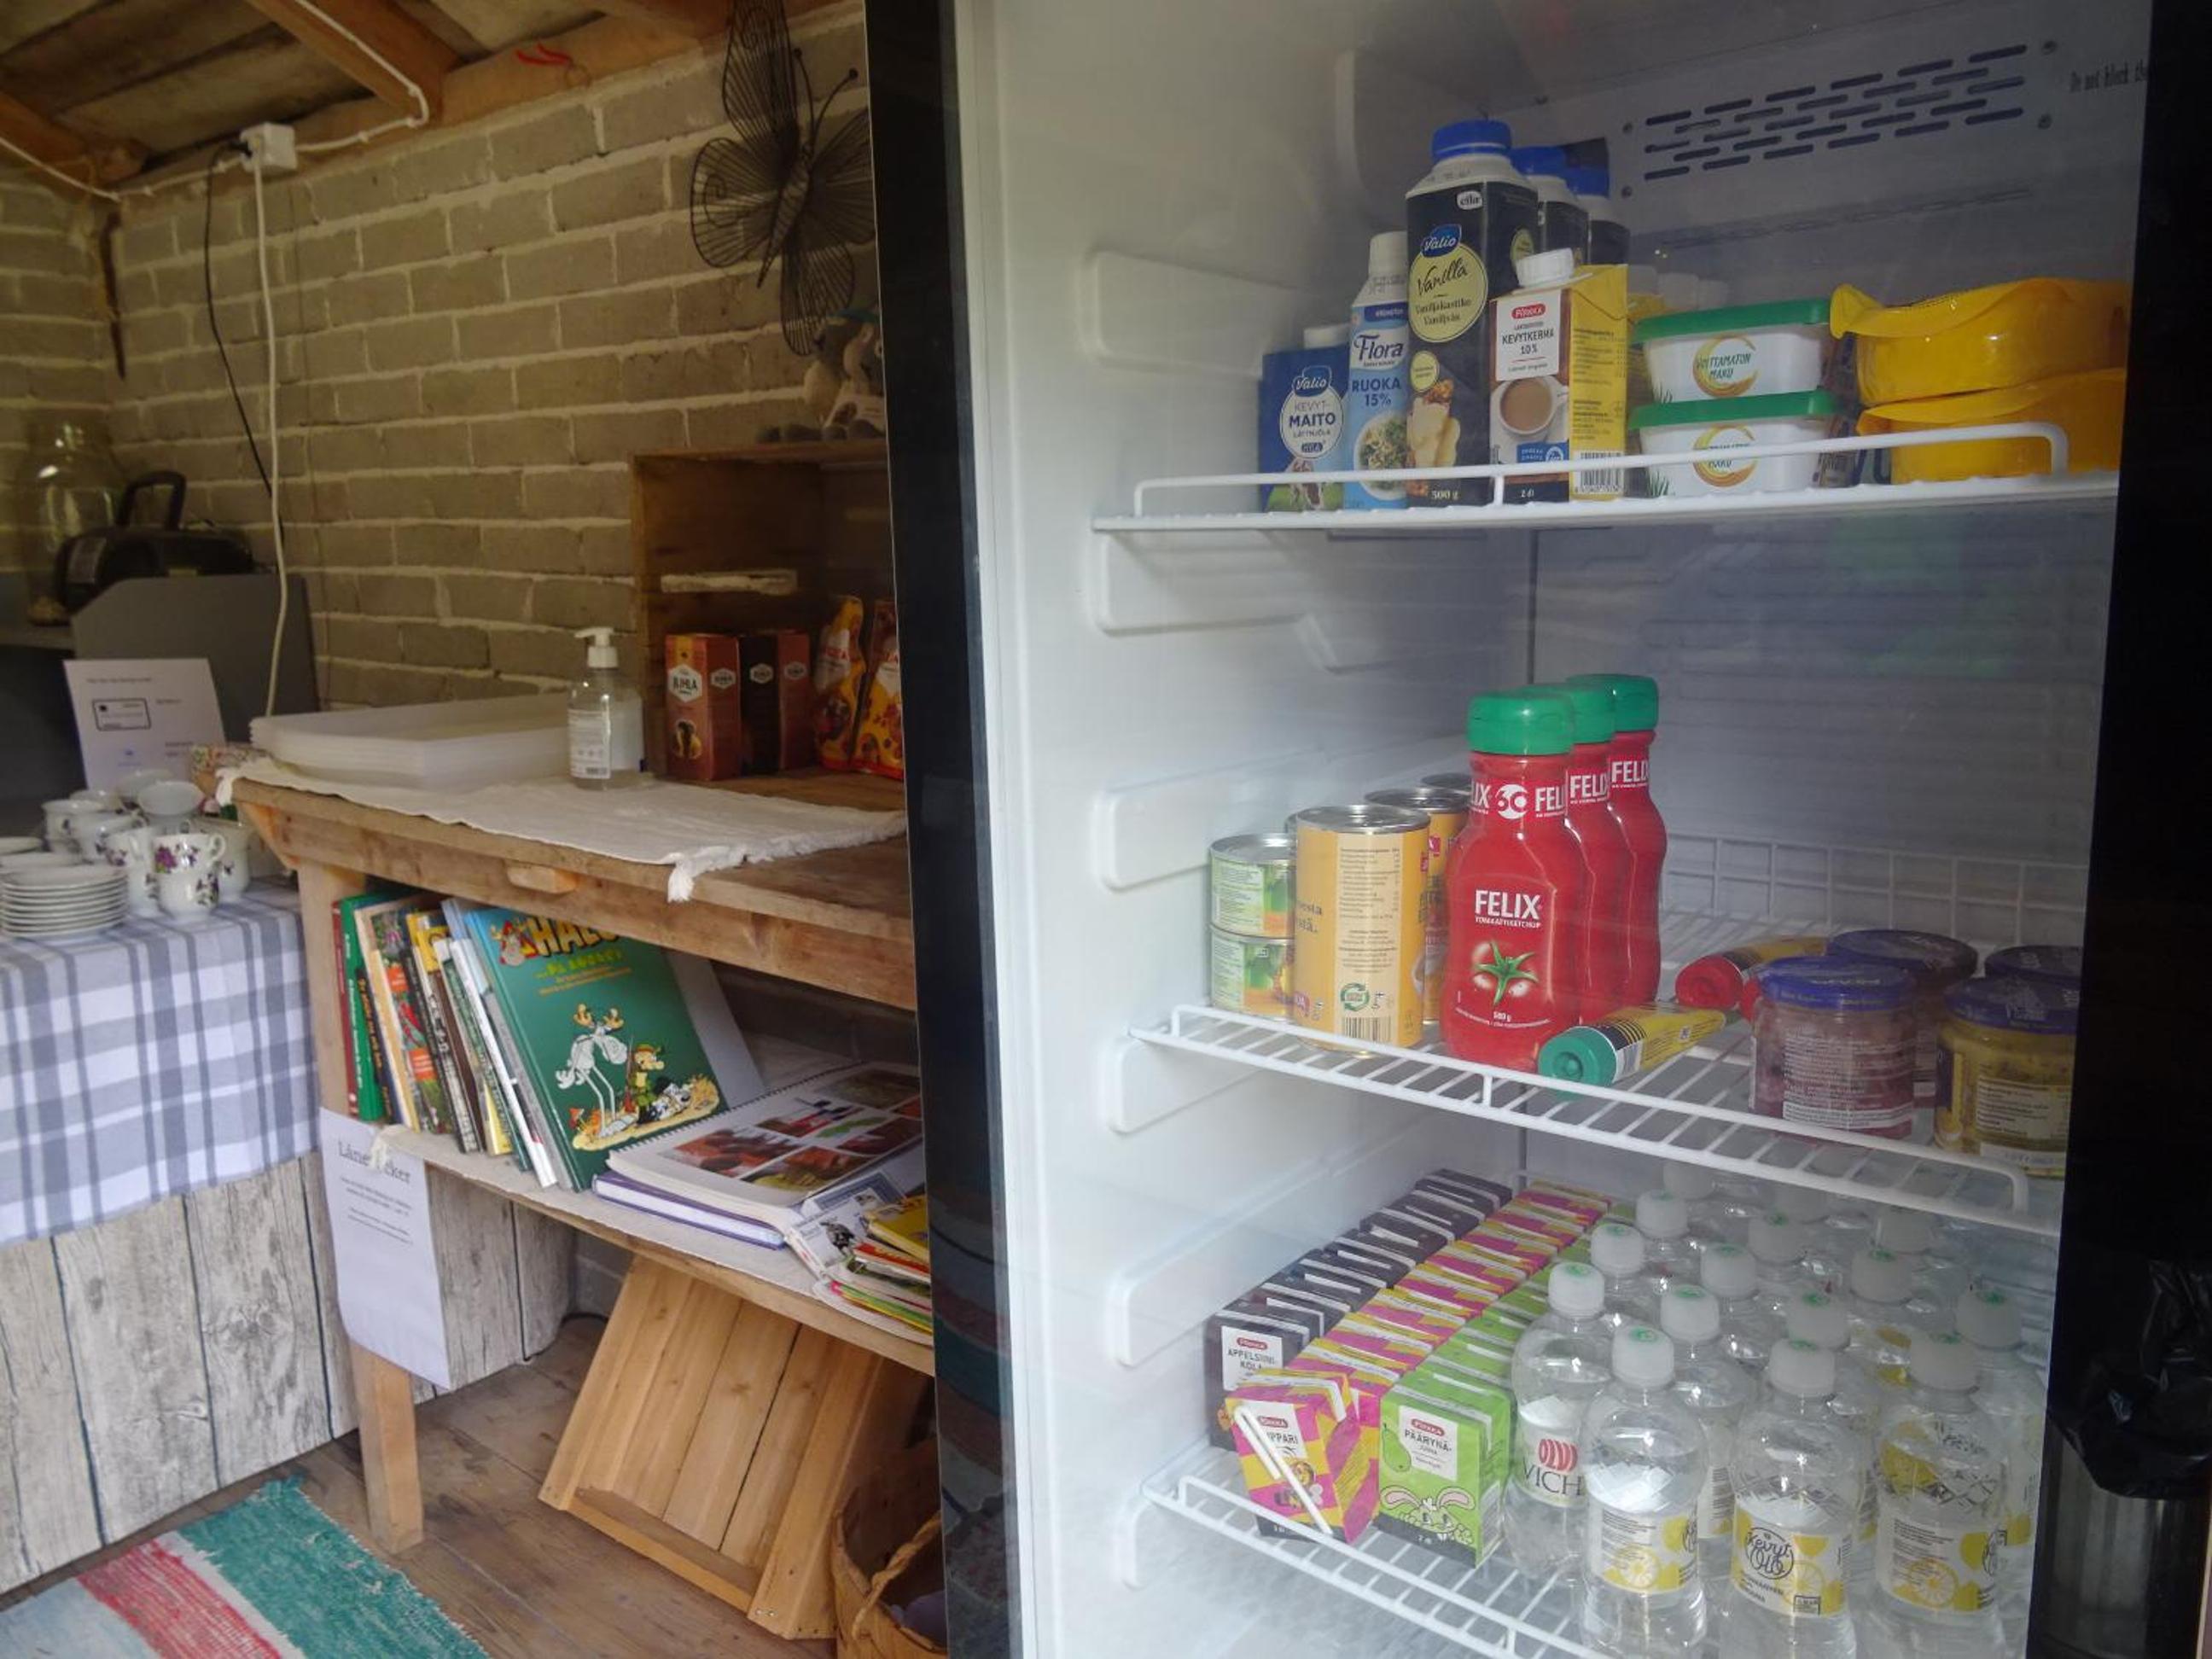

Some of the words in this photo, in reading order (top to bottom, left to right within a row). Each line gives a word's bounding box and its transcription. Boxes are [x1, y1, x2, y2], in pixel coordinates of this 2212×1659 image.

[1424, 236, 1456, 251] Valio
[1417, 258, 1468, 295] Vanilla
[1353, 335, 1404, 360] Flora
[1295, 377, 1327, 390] Valio
[1352, 377, 1401, 393] RUOKA
[1365, 393, 1392, 407] 15%
[1289, 412, 1336, 428] MAITO
[1475, 889, 1541, 920] FELIX
